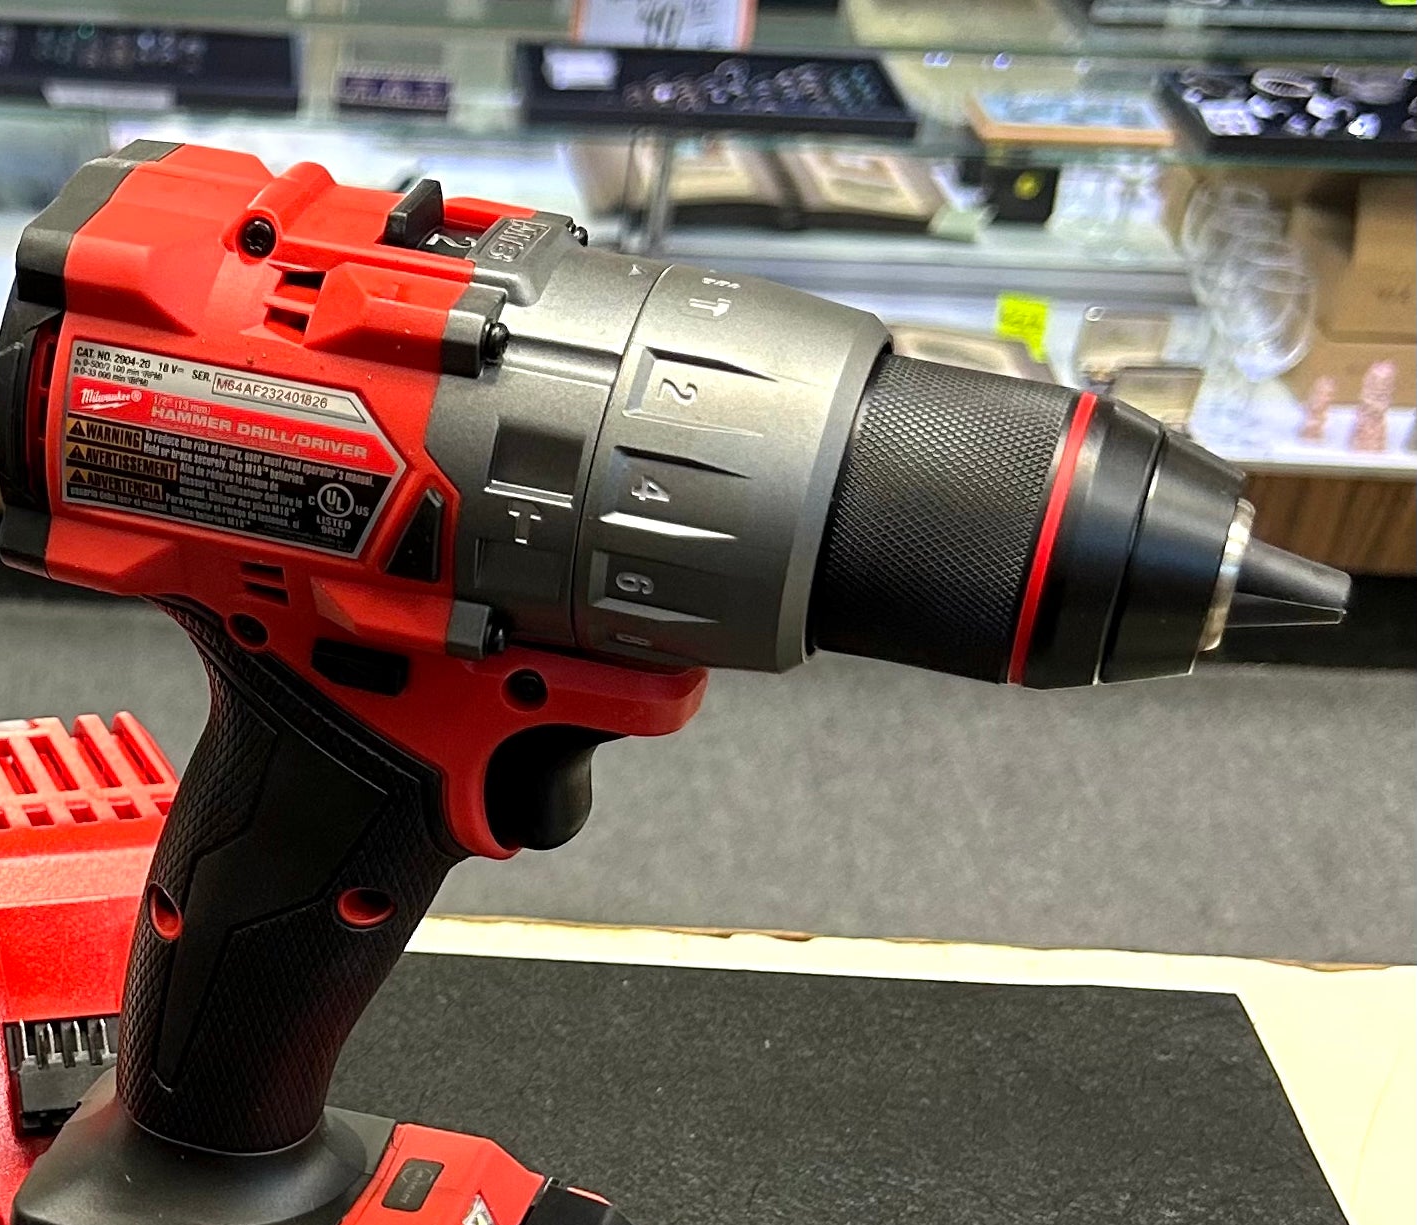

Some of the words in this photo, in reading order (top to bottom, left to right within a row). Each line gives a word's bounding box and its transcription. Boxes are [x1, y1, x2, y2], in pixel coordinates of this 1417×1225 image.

[114, 354, 151, 369] 2904-20
[192, 370, 212, 382] SER.
[659, 378, 699, 405] 2
[86, 422, 141, 448] WARNING
[151, 406, 232, 431] HAMMER
[236, 422, 368, 460] DRILL/DRIVER
[86, 448, 176, 480] AVERTISSEMENT
[87, 471, 161, 500] ADVERTENCIA
[631, 476, 670, 503] 4
[316, 514, 352, 530] LISTED
[616, 571, 655, 597] 6
